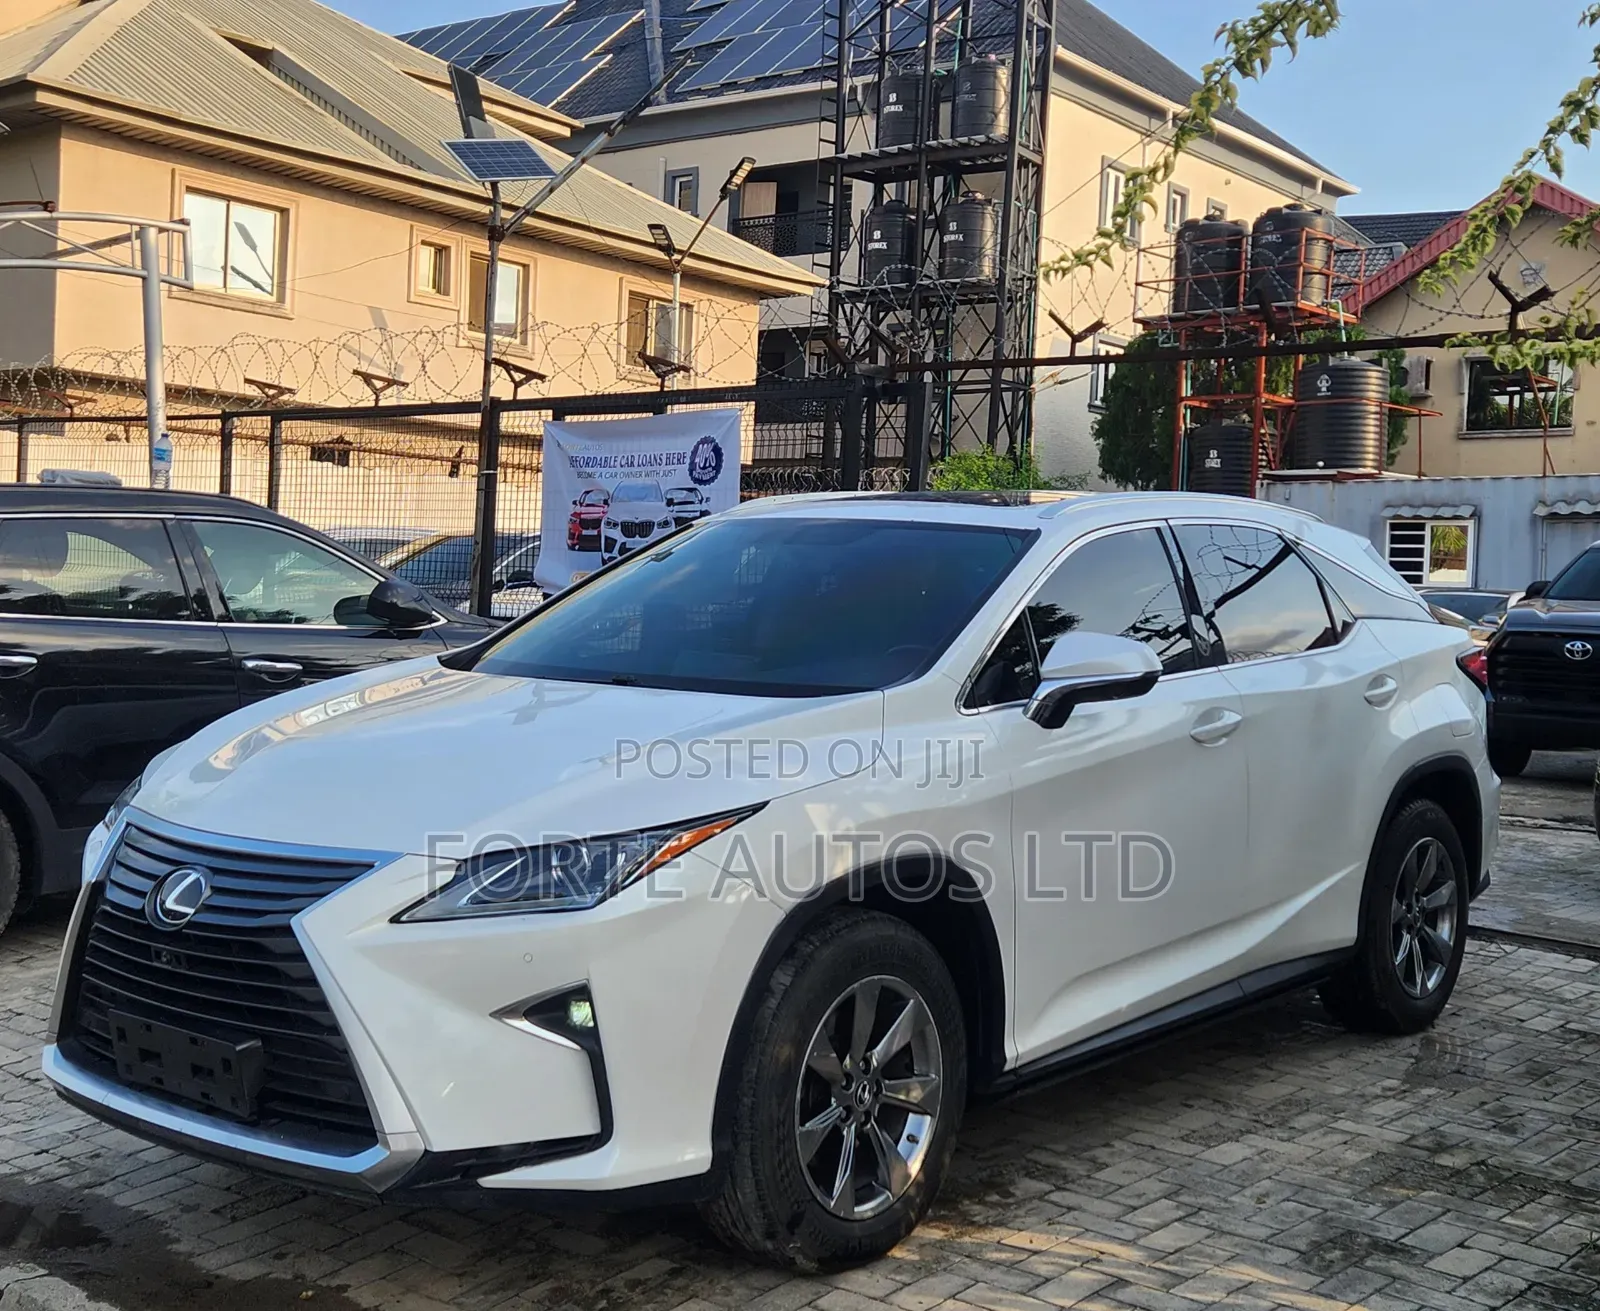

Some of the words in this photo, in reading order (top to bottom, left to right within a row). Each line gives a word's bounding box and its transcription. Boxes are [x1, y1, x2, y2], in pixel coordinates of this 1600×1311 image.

[867, 241, 888, 251] STOREX
[620, 454, 635, 468] CAR
[637, 453, 663, 467] LOANS
[665, 451, 687, 466] HERE
[604, 471, 618, 479] CAR
[619, 470, 643, 479] OWNER
[644, 469, 660, 478] WITH
[661, 468, 677, 478] JUST
